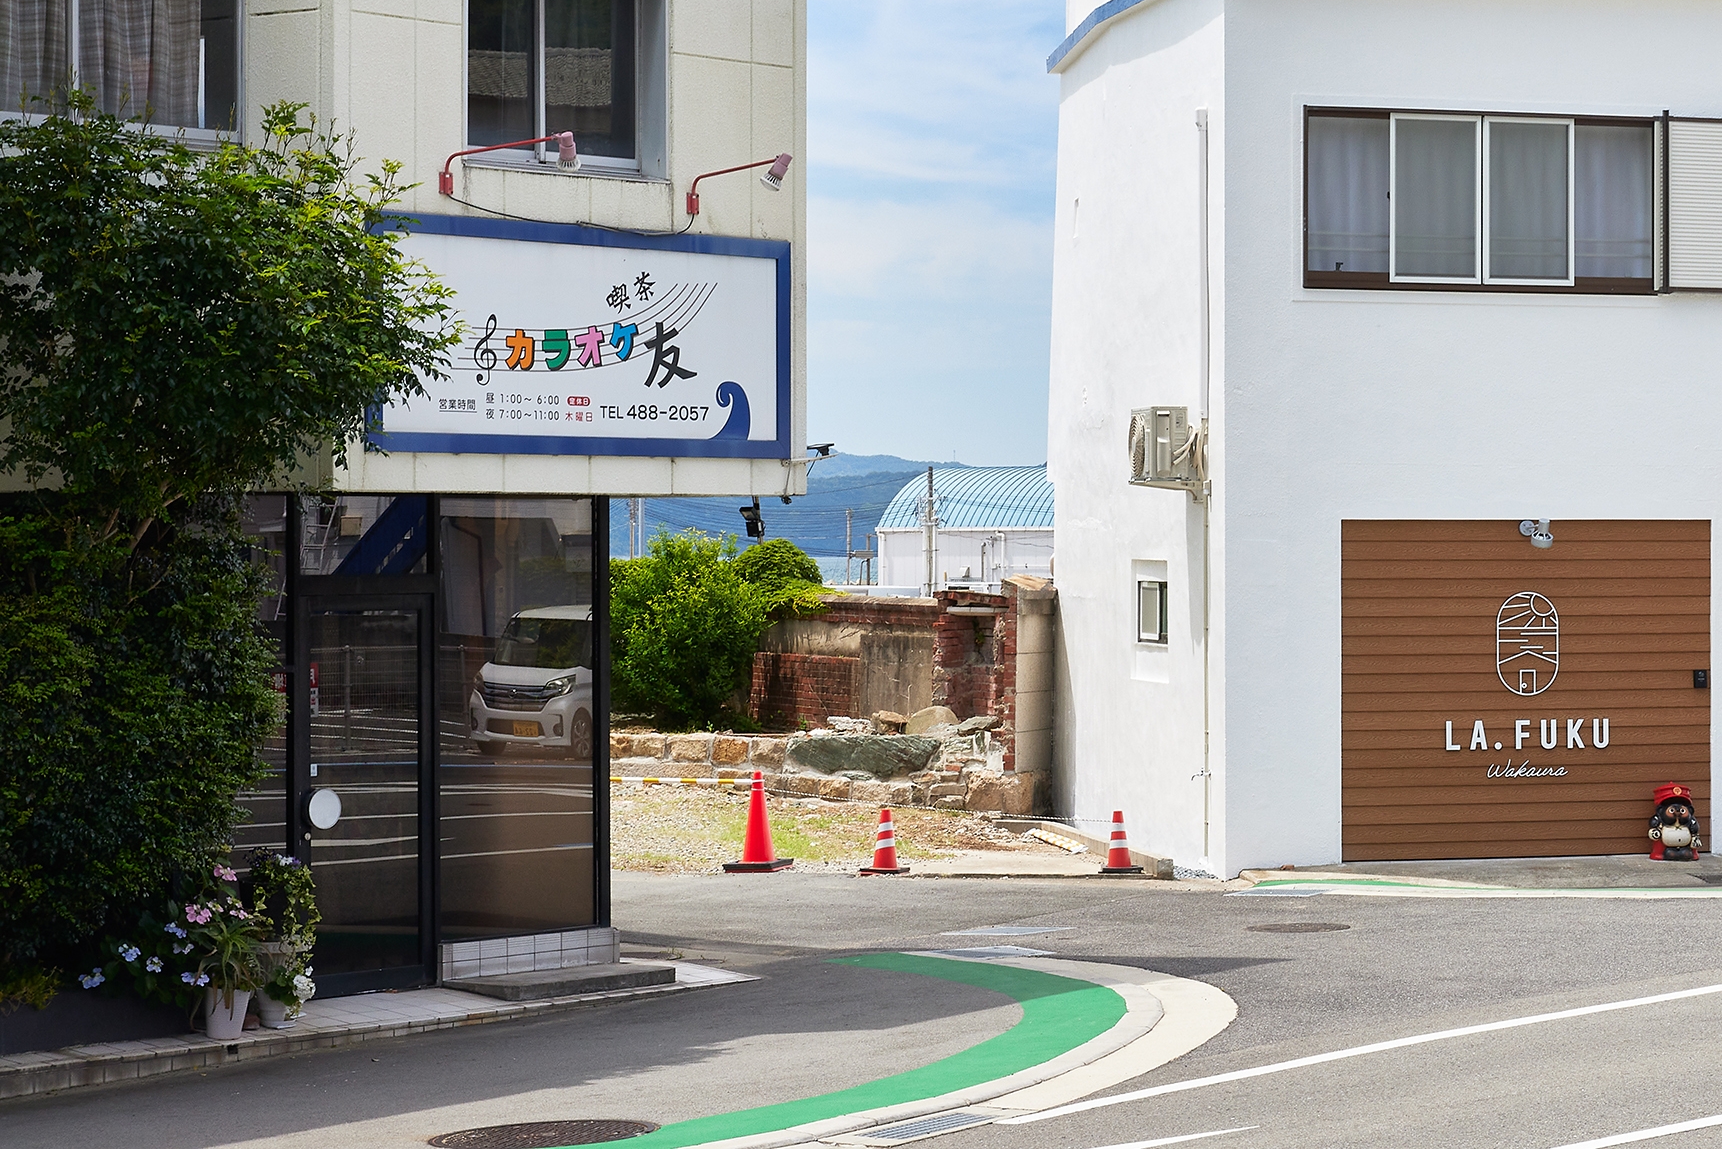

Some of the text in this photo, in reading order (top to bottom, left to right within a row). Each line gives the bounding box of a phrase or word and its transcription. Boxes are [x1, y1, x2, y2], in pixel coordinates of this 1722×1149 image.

[606, 271, 656, 313] 喫茶
[505, 321, 697, 388] カラオケ 友
[438, 399, 476, 411] 営業時間
[486, 392, 495, 404] 昼
[485, 408, 495, 420] 夜
[565, 411, 593, 422] 木曜日
[600, 404, 709, 422] TEL 488-2057
[1445, 718, 1610, 751] LA.FUKU
[1486, 759, 1569, 779] Wakaura
